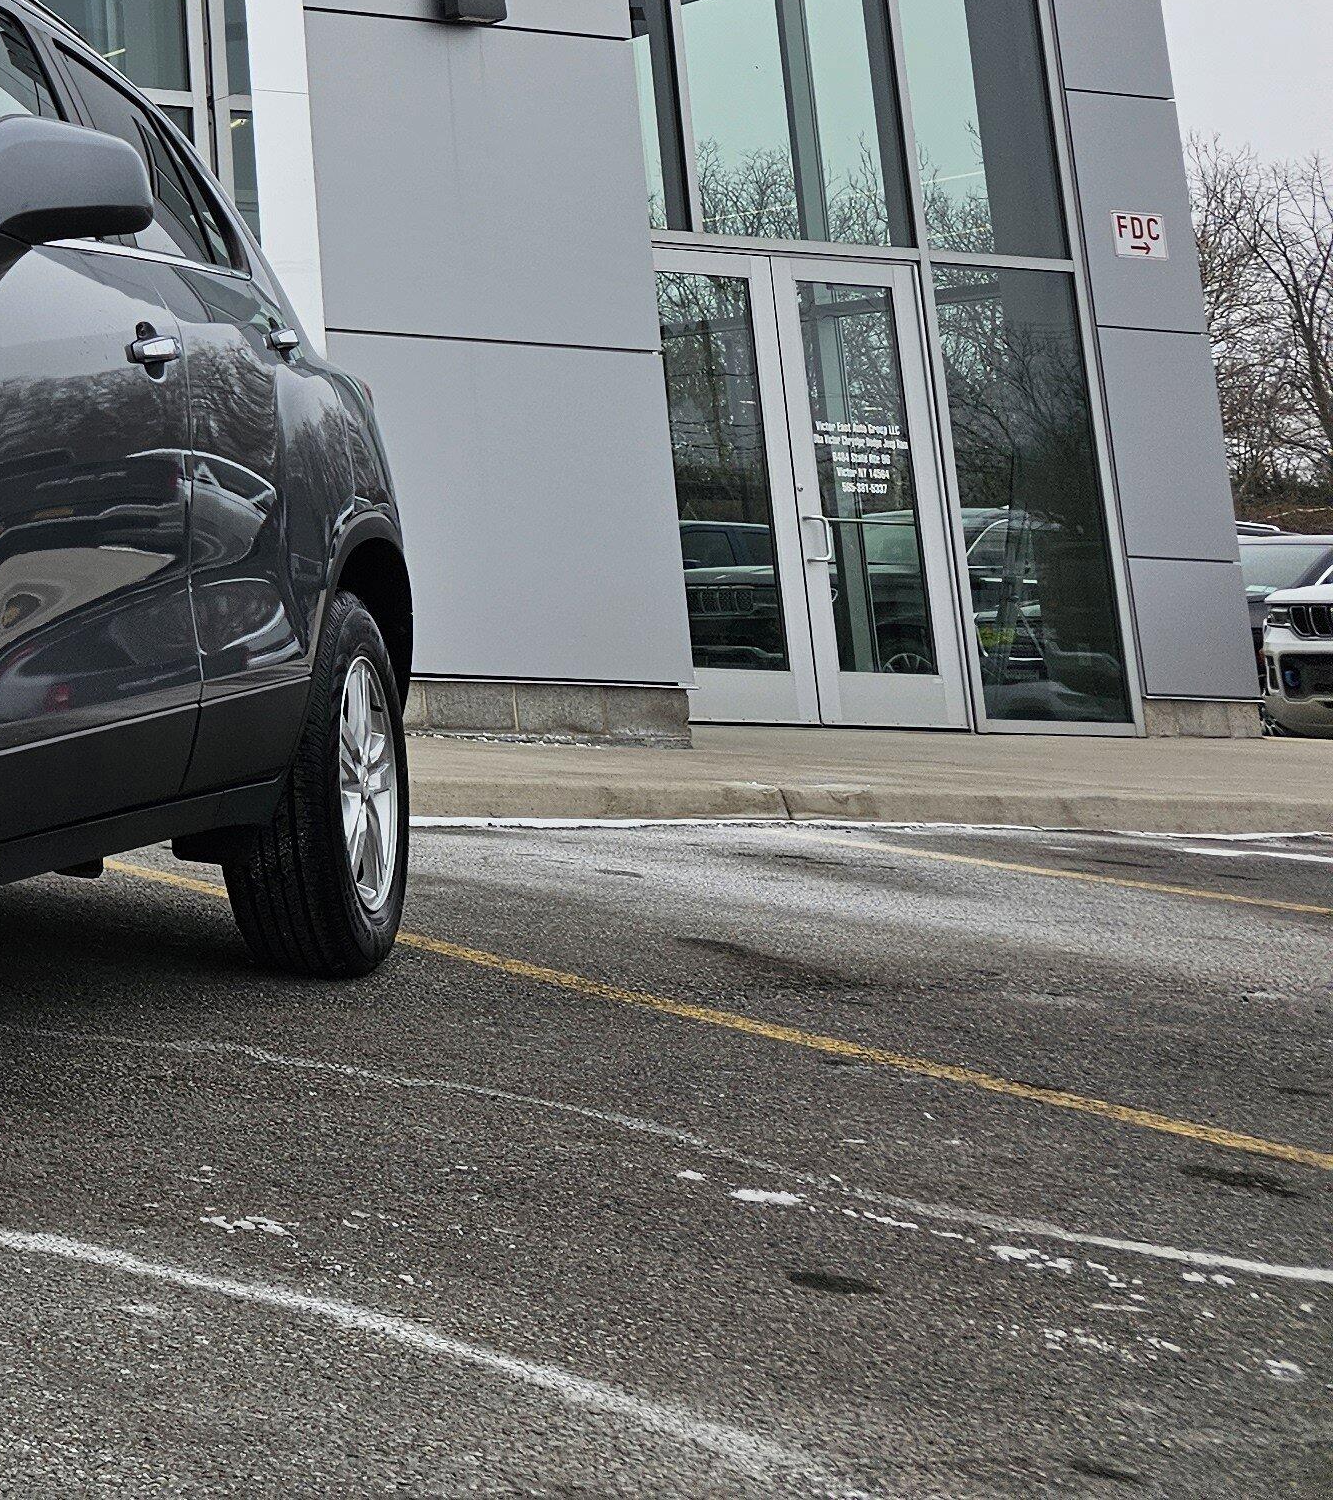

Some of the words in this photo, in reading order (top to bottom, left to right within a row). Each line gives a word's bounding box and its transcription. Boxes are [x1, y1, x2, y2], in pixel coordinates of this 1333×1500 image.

[1116, 215, 1160, 240] FDC
[815, 420, 836, 432] Victor
[868, 423, 888, 437] Group
[888, 424, 901, 436] LLC
[836, 466, 858, 478] Victor
